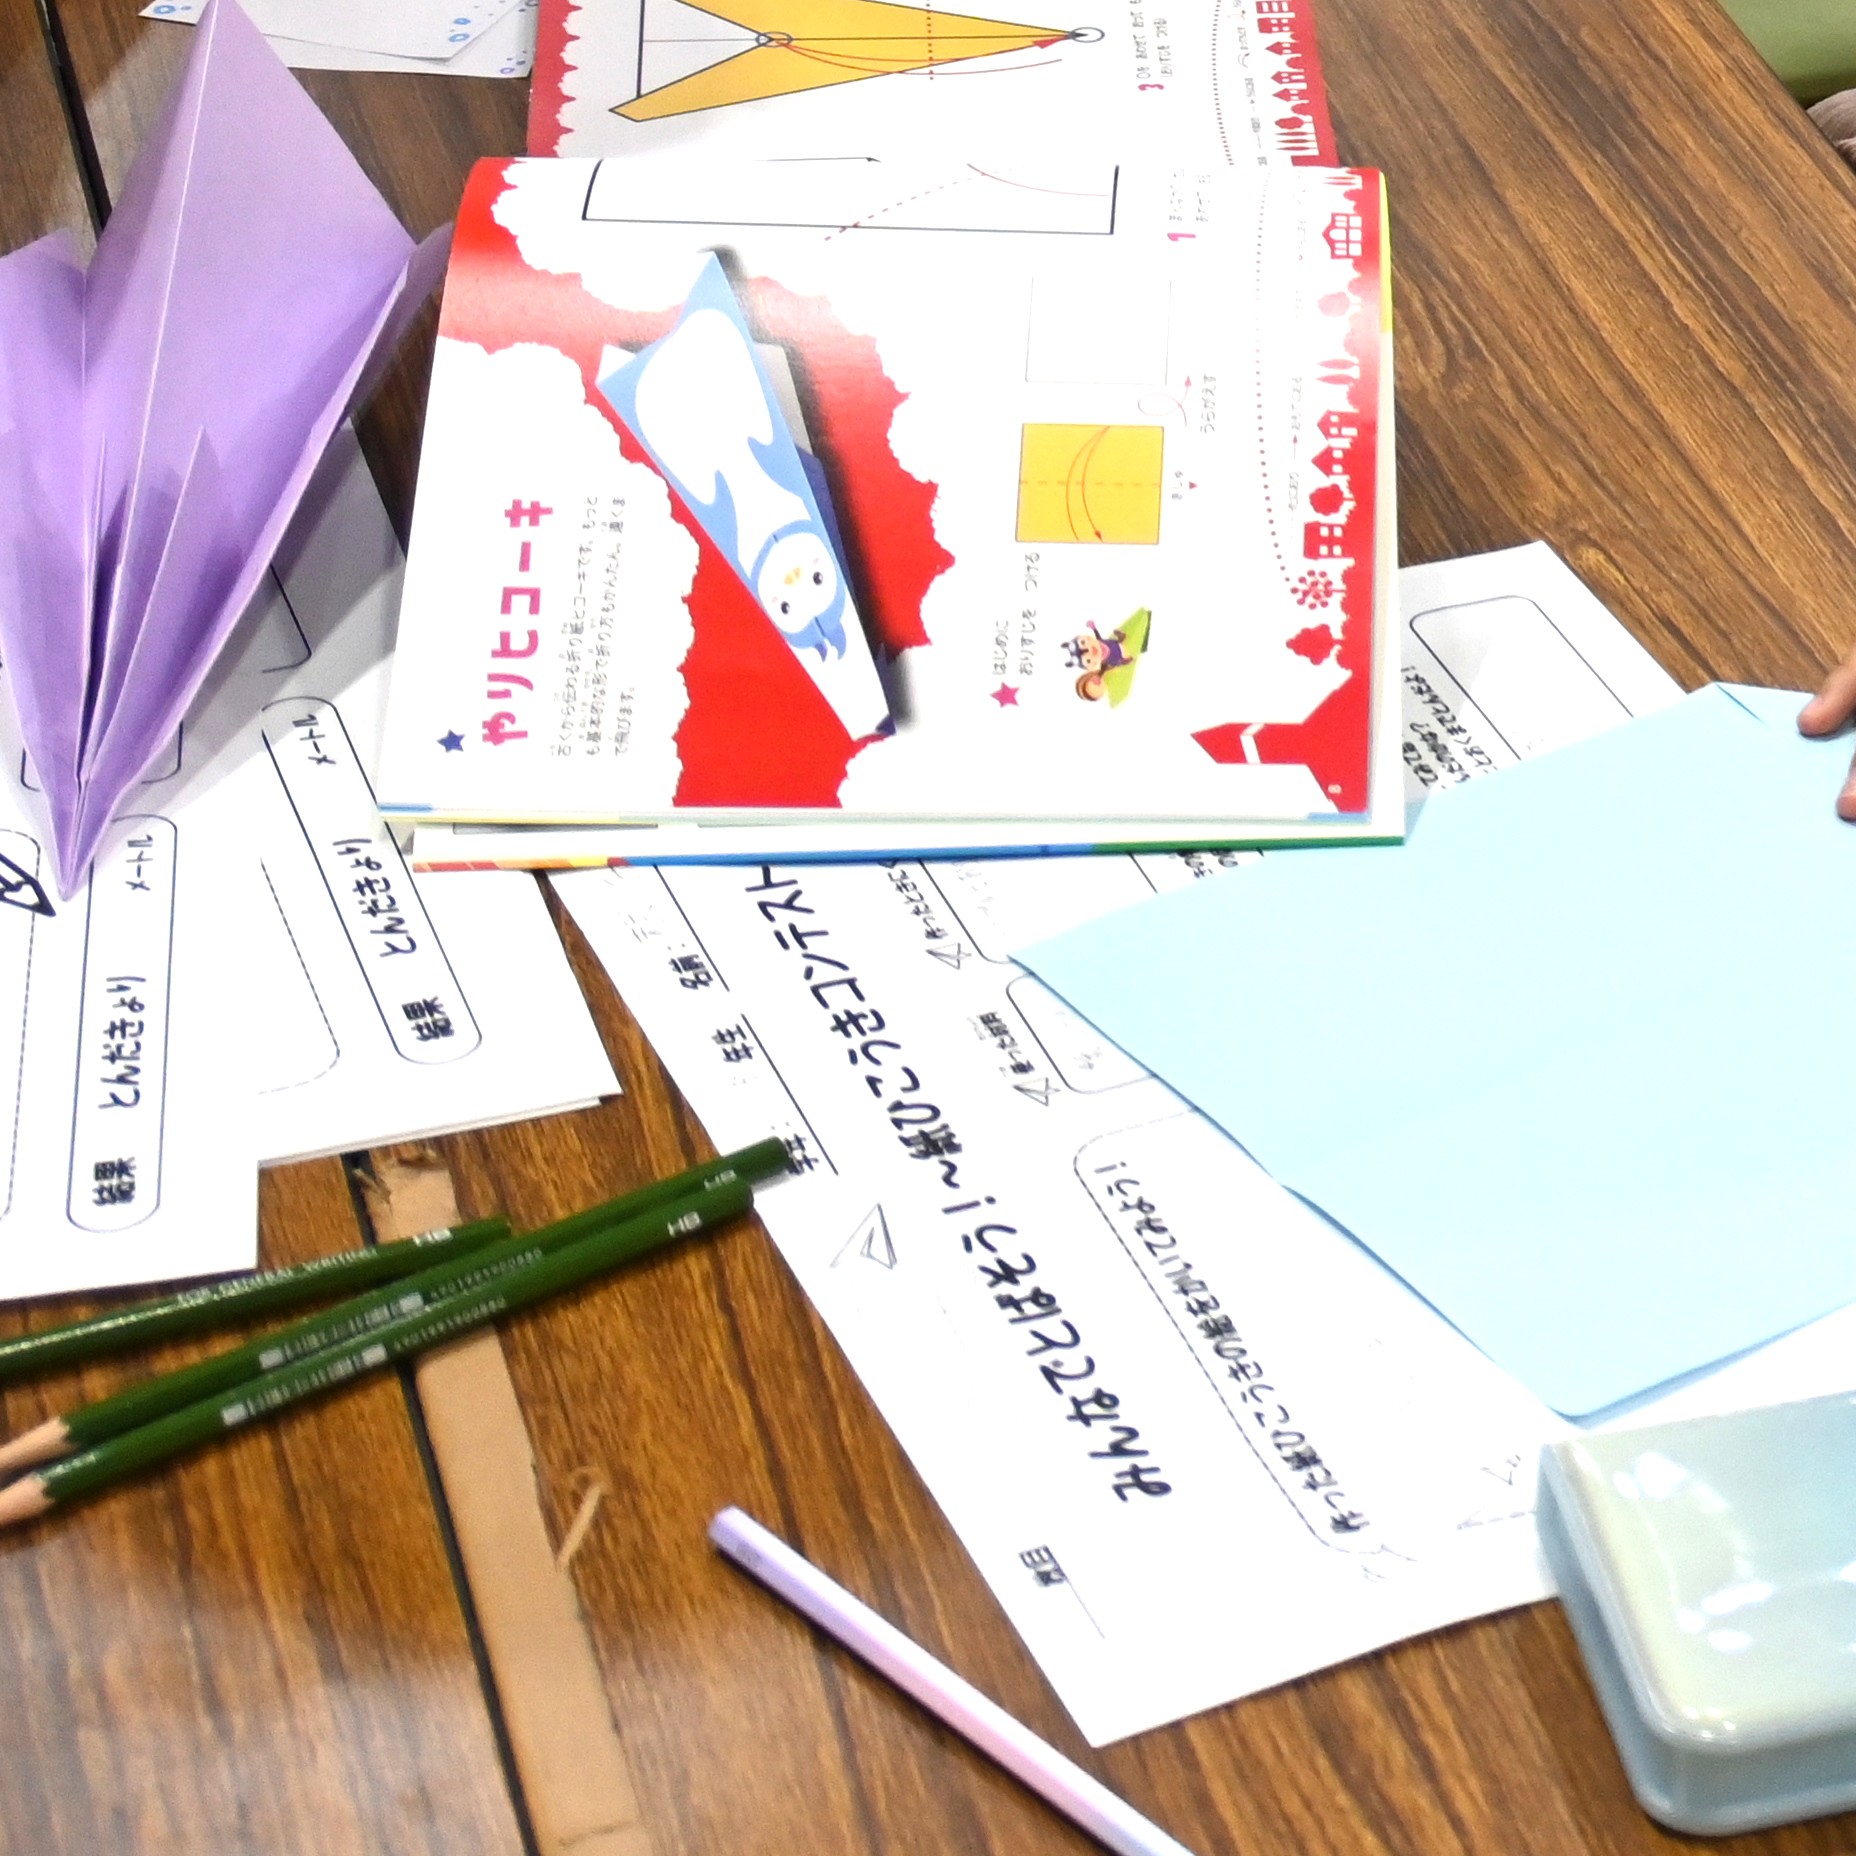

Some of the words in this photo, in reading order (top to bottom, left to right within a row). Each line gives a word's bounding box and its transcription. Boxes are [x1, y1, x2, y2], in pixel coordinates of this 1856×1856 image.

[1024, 551, 1040, 591] つける
[482, 499, 553, 746] やりヒコーキ
[991, 620, 1010, 676] はじめに
[291, 713, 337, 767] メートル
[1401, 666, 1498, 774] とおくまでとんだよ!
[126, 834, 154, 892] メートル
[332, 837, 418, 958] とんだきょり
[98, 975, 146, 1110] とんだきょり
[400, 995, 456, 1043] 結果
[712, 1022, 755, 1064] 年生
[92, 1156, 137, 1206] 結果
[667, 1211, 702, 1237] HB
